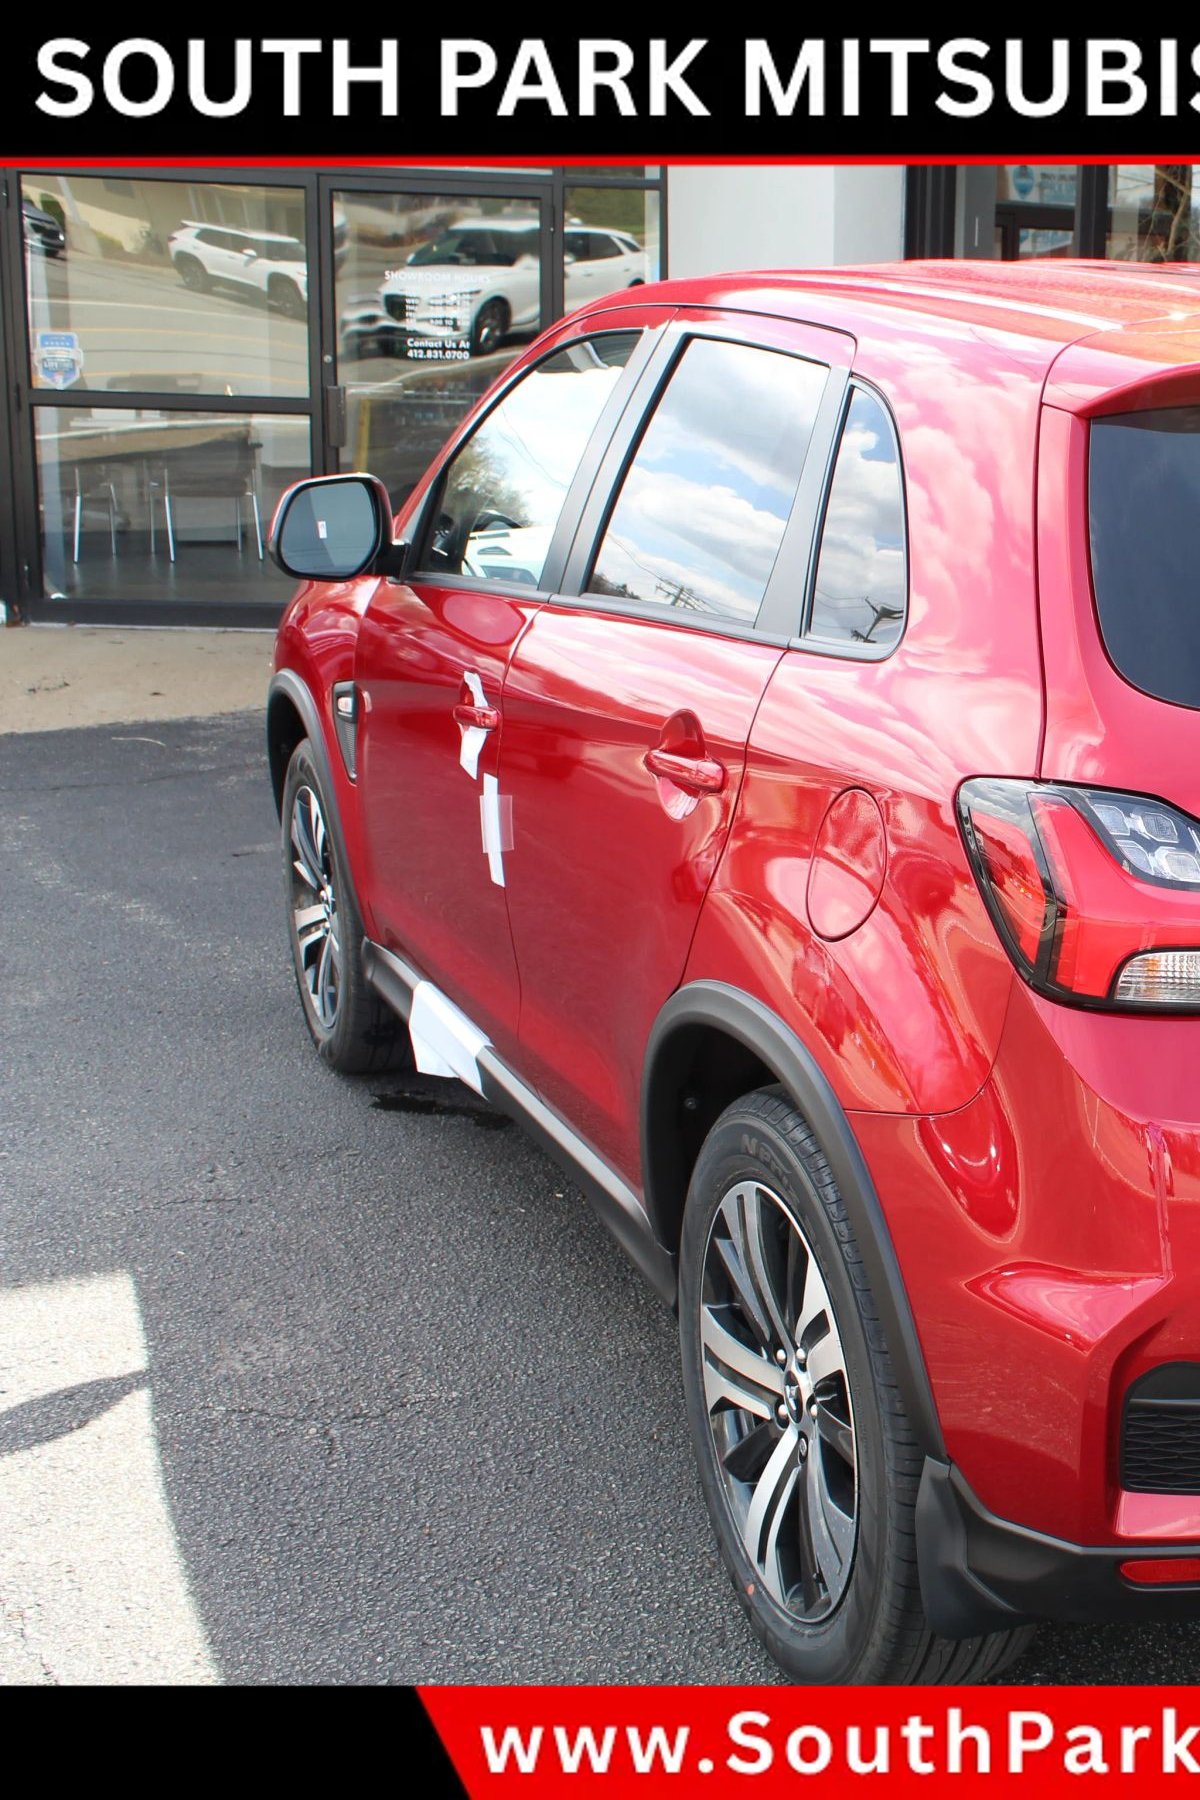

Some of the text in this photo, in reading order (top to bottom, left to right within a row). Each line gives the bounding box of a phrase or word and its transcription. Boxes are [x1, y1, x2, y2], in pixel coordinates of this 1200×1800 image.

[407, 338, 471, 349] Contact Us At
[407, 349, 470, 360] 412.831.0700
